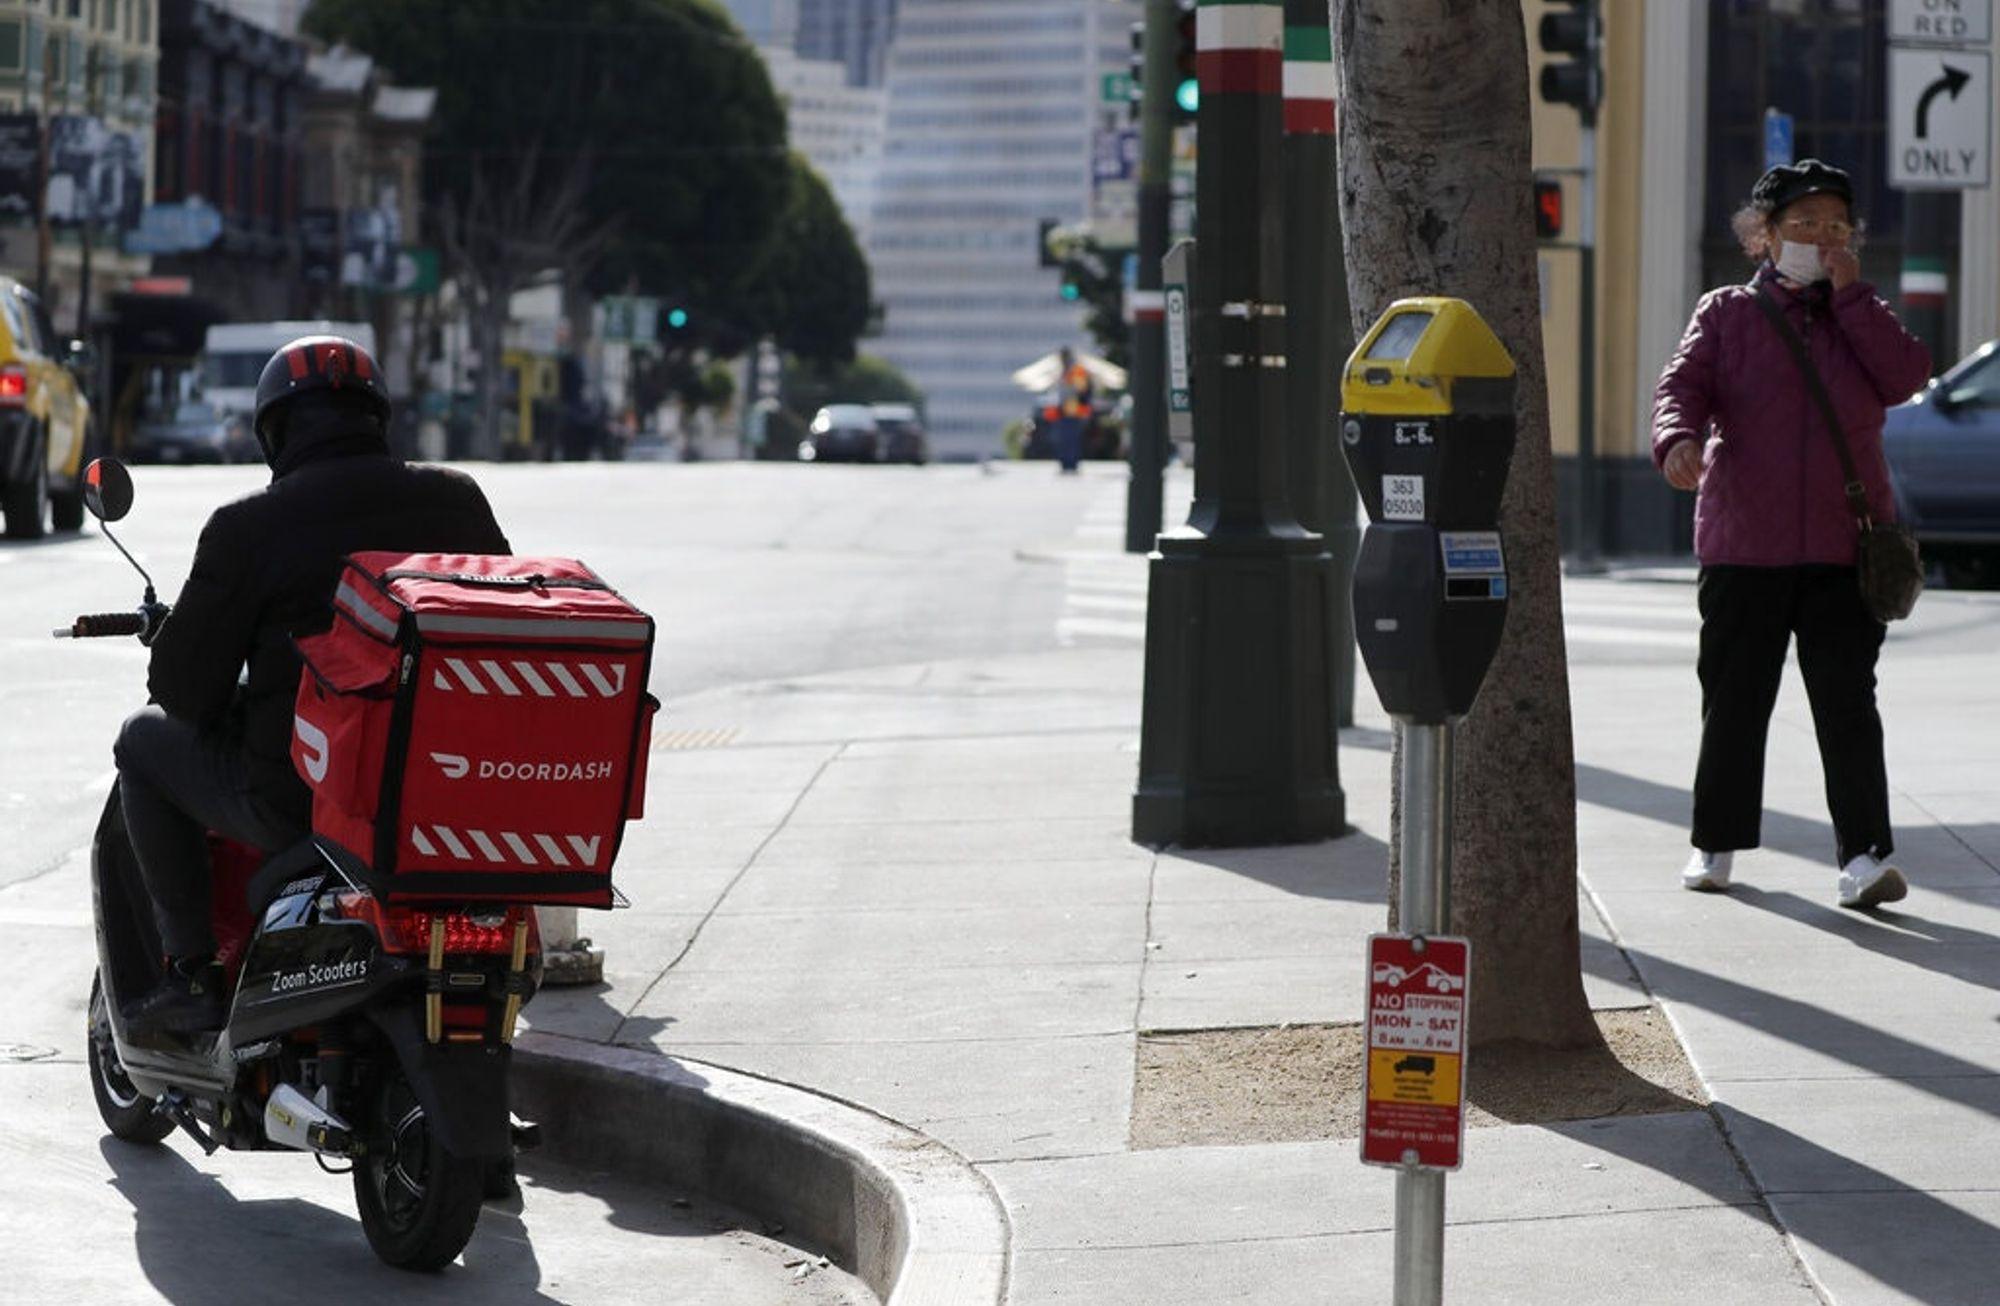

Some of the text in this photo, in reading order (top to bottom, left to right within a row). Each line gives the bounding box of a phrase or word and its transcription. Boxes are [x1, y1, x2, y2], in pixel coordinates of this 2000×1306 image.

[1922, 0, 1960, 12] ON
[1914, 15, 1968, 35] RED
[1905, 147, 1975, 174] ONLY
[1391, 479, 1414, 494] 363
[1384, 499, 1423, 514] 05030
[479, 761, 612, 781] DOORDASH
[272, 960, 367, 992] Zoom Scooters
[1375, 994, 1459, 1010] NO STOPPING
[1375, 1014, 1411, 1028] MON
[1429, 1017, 1457, 1031] SAT
